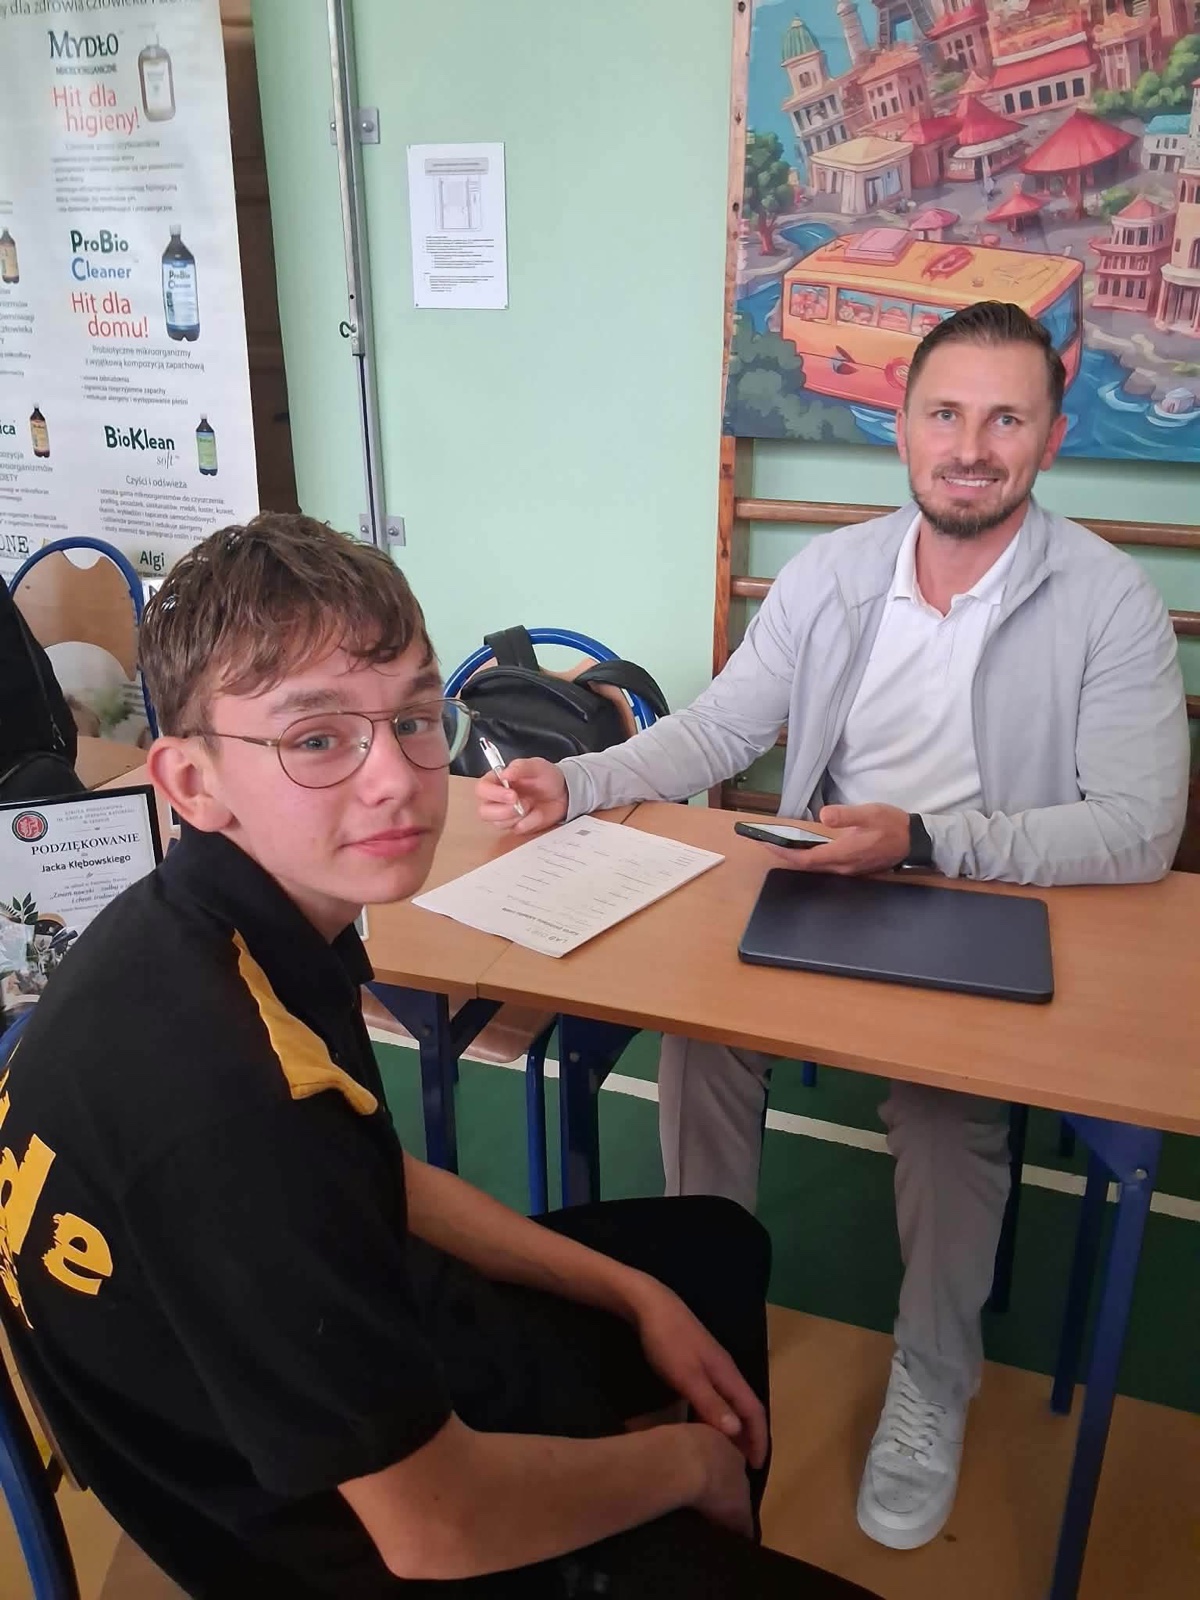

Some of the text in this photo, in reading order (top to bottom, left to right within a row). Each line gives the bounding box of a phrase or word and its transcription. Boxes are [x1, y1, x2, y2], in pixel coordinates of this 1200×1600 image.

[52, 83, 117, 107] Hit dla
[65, 106, 140, 137] higieny!
[70, 229, 129, 253] ProBio
[71, 257, 132, 281] Cleaner
[71, 291, 131, 314] Hit dla
[88, 314, 149, 338] domu!
[104, 425, 175, 450] BioKlean
[140, 550, 165, 571] Algi
[31, 832, 140, 856] PODZIĘKOWANIE
[41, 854, 131, 873] Jacka Kłębowskiego
